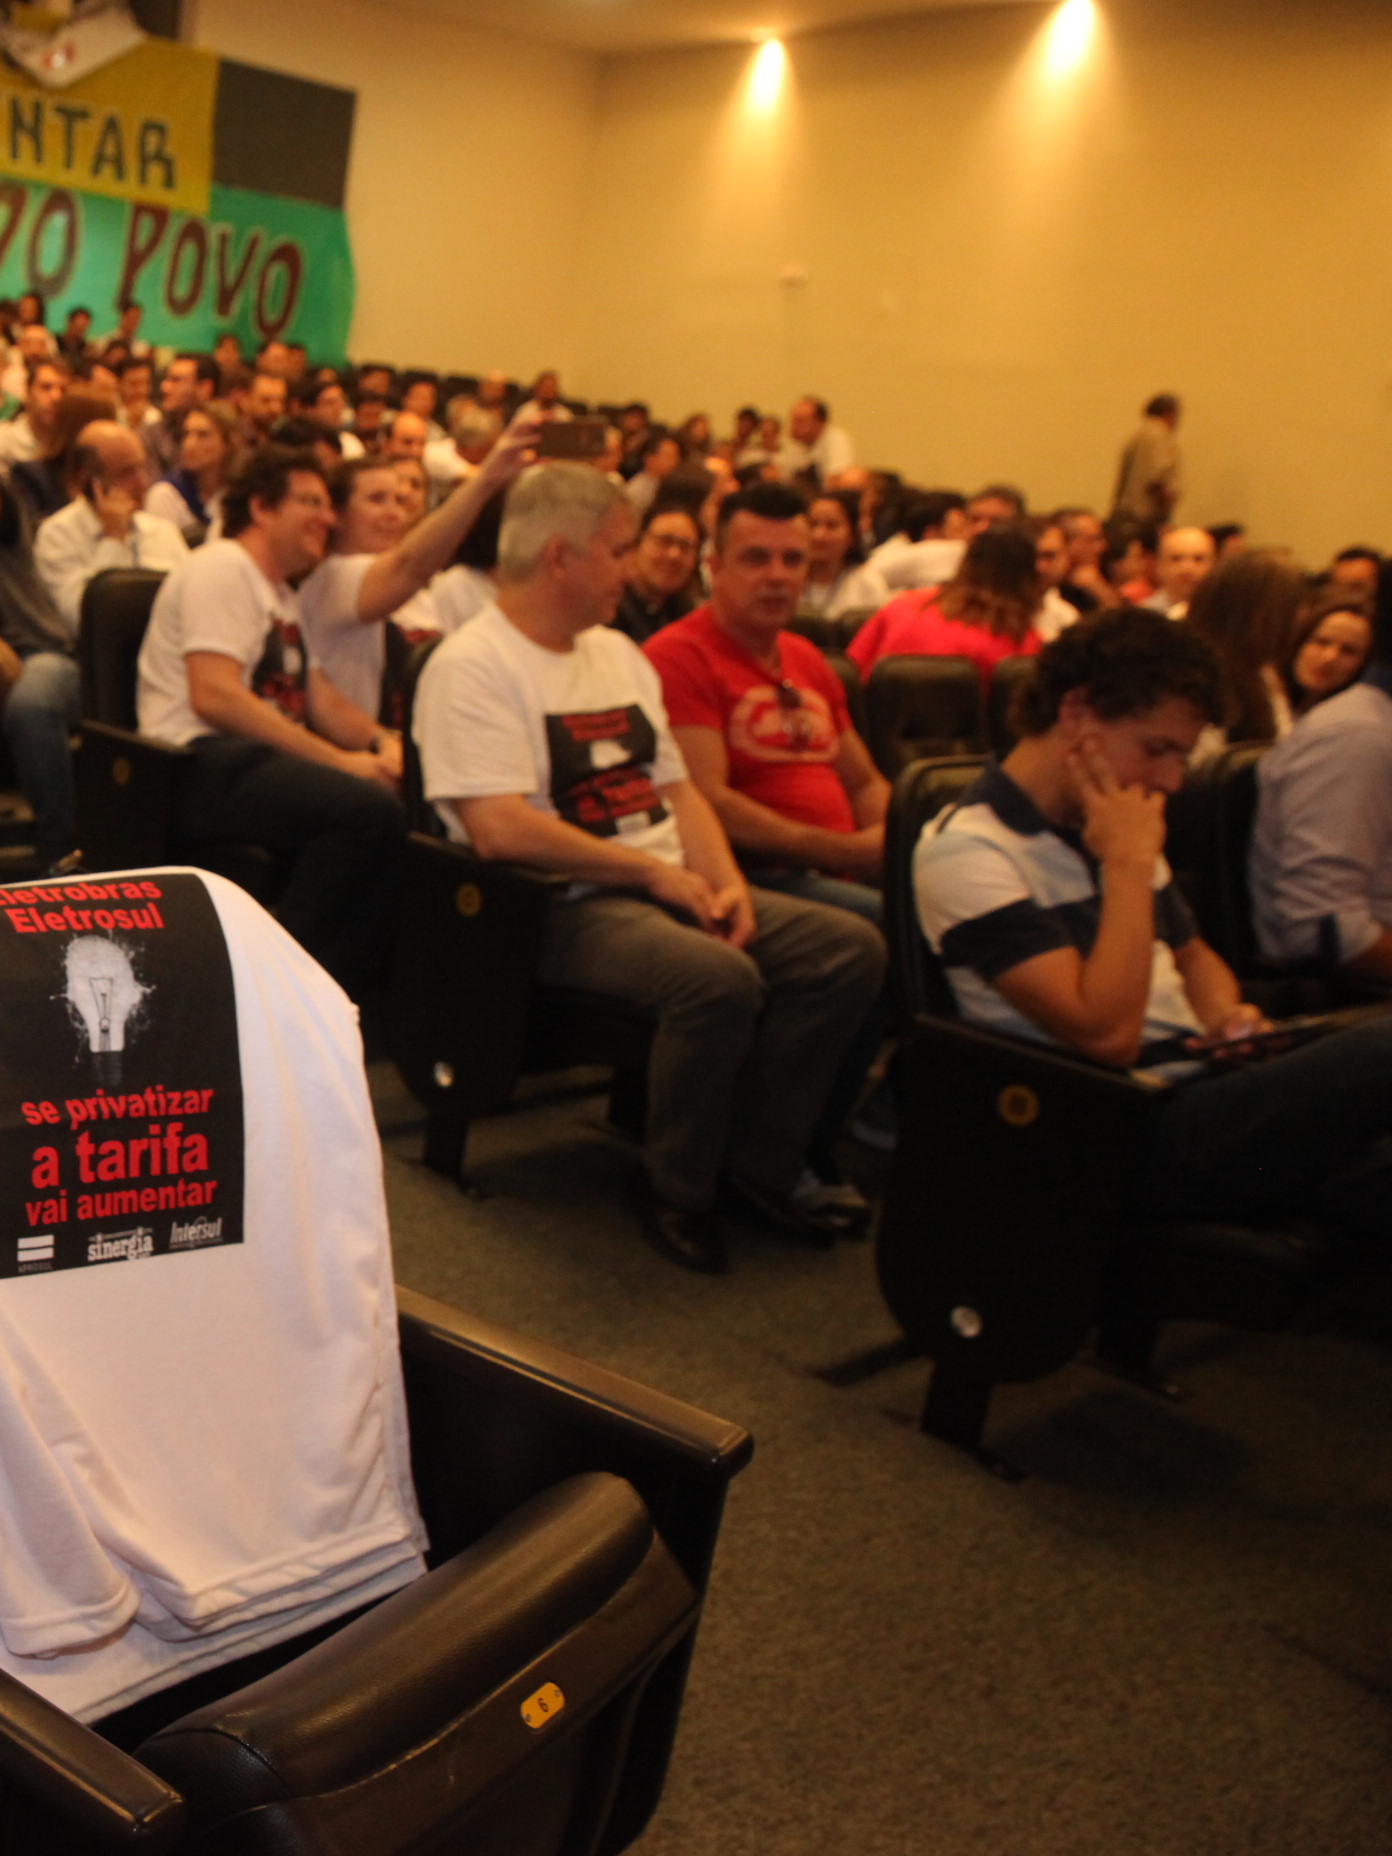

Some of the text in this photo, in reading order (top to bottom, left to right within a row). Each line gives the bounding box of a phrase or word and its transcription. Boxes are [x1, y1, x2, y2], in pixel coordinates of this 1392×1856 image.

[116, 200, 302, 342] POVO
[4, 903, 164, 933] Eletrosul
[21, 1085, 213, 1130] se privatizar
[31, 1123, 208, 1189] a tarifa
[25, 1179, 217, 1226] vai aumentar
[88, 1230, 153, 1261] sinergia
[170, 1217, 222, 1244] Intersul
[537, 1697, 549, 1712] 6
